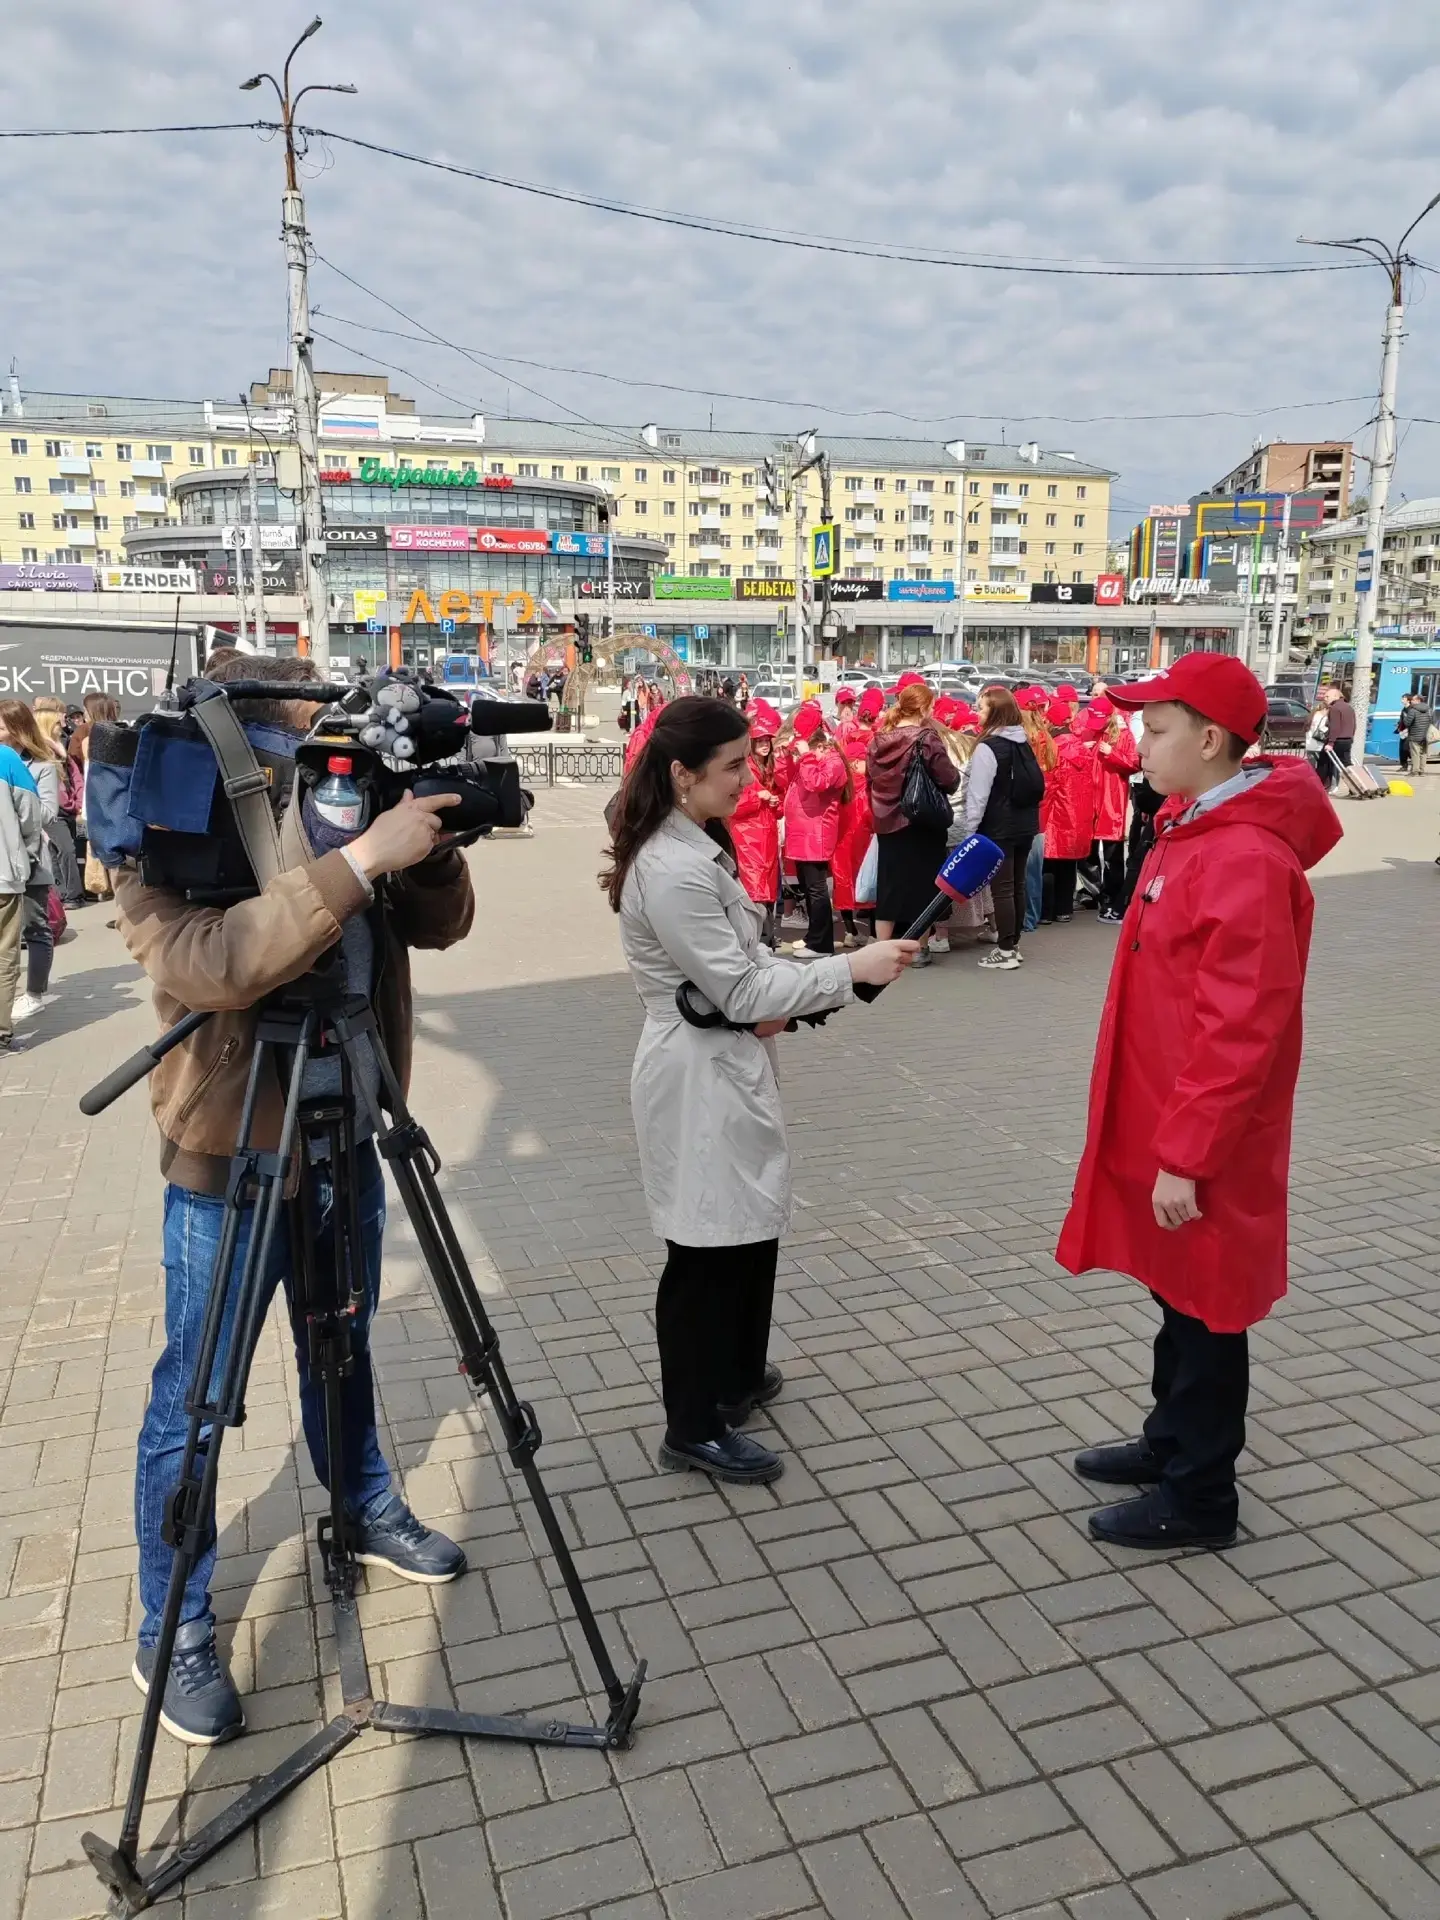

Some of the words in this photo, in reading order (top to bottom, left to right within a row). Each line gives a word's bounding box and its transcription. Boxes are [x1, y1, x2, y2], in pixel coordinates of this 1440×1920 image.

[360, 458, 478, 491] Окрошка
[1149, 504, 1191, 516] DNS
[416, 530, 452, 539] МАГНИТ
[416, 539, 466, 548] КОСМЕТИК
[517, 541, 546, 550] ОБУВЬ
[7, 580, 41, 588] САЛОН
[45, 581, 80, 589] СУМОК
[122, 573, 192, 588] ZENDEN
[1173, 579, 1211, 602] JEANS
[40, 654, 90, 663] ФЕДЕРАЛЬНАЯ
[90, 656, 142, 665] ТРАНСПОРТНАЯ
[143, 658, 180, 666] КОМПАНЯ
[1390, 666, 1409, 675] 489
[942, 837, 980, 878] РОССИЯ
